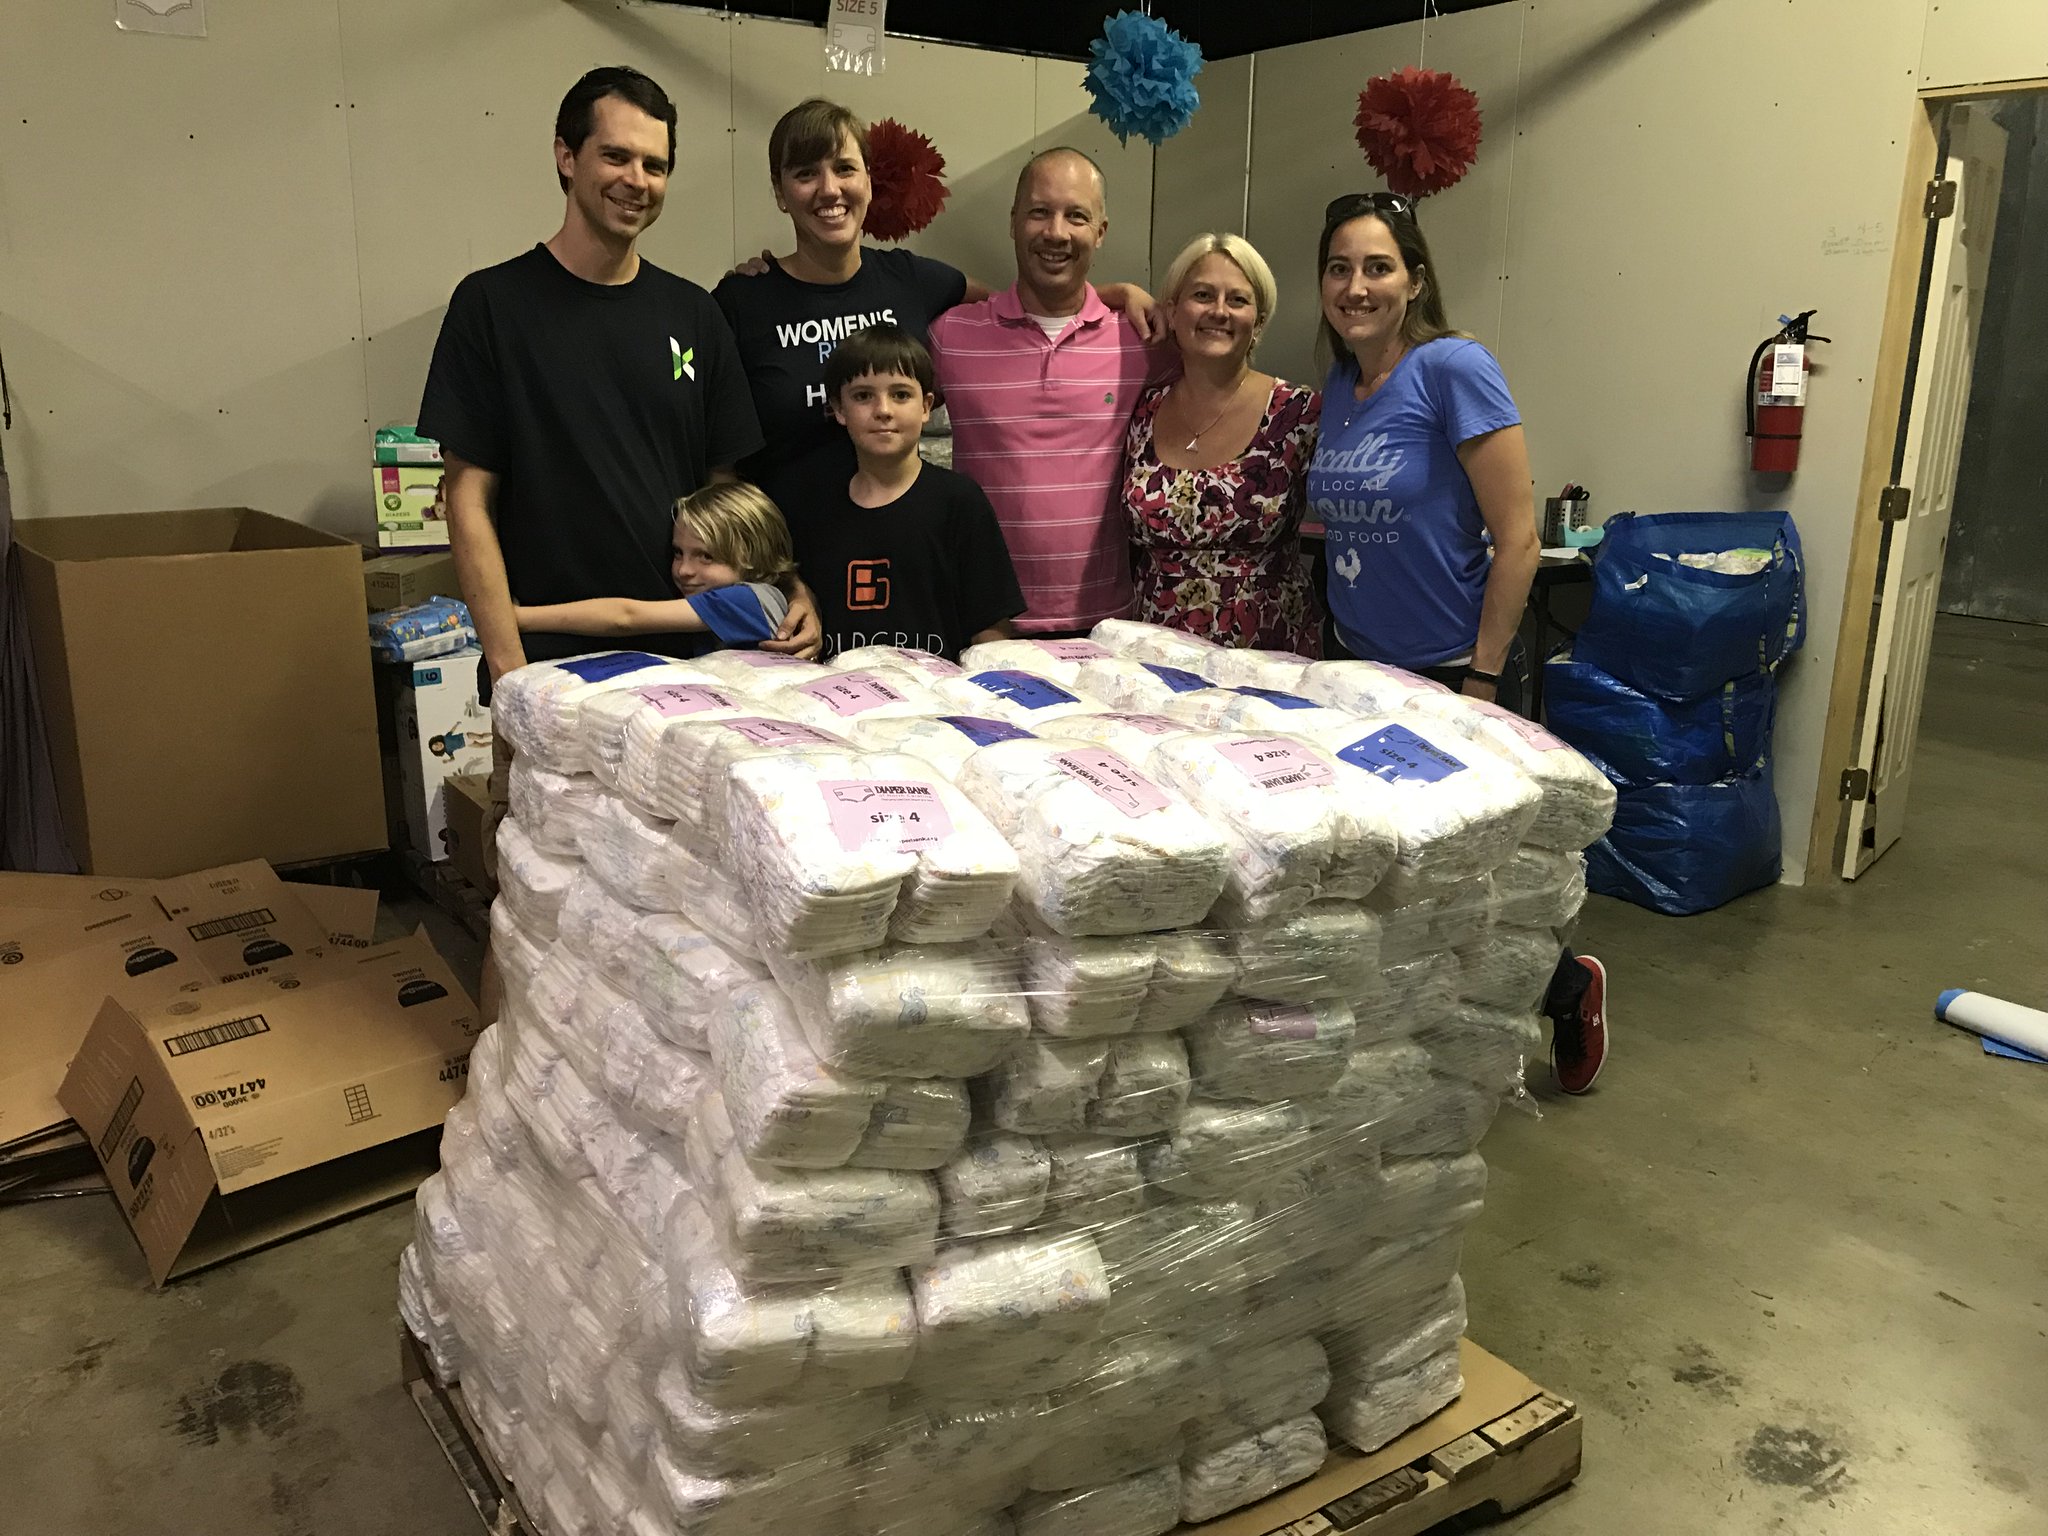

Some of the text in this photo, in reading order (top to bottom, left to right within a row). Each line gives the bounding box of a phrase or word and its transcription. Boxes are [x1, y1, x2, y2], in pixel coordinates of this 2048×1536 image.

[836, 0, 878, 15] SIZE 5
[776, 308, 898, 348] WOMEN'S
[1322, 480, 1389, 491] LOCAL
[1349, 532, 1400, 543] FOOD
[833, 685, 852, 695] size
[1254, 750, 1291, 762] size 4
[1380, 748, 1407, 763] size
[1111, 768, 1139, 787] size
[874, 786, 931, 795] DIAPER BANK
[909, 812, 921, 822] 4
[439, 1063, 470, 1082] 4474
